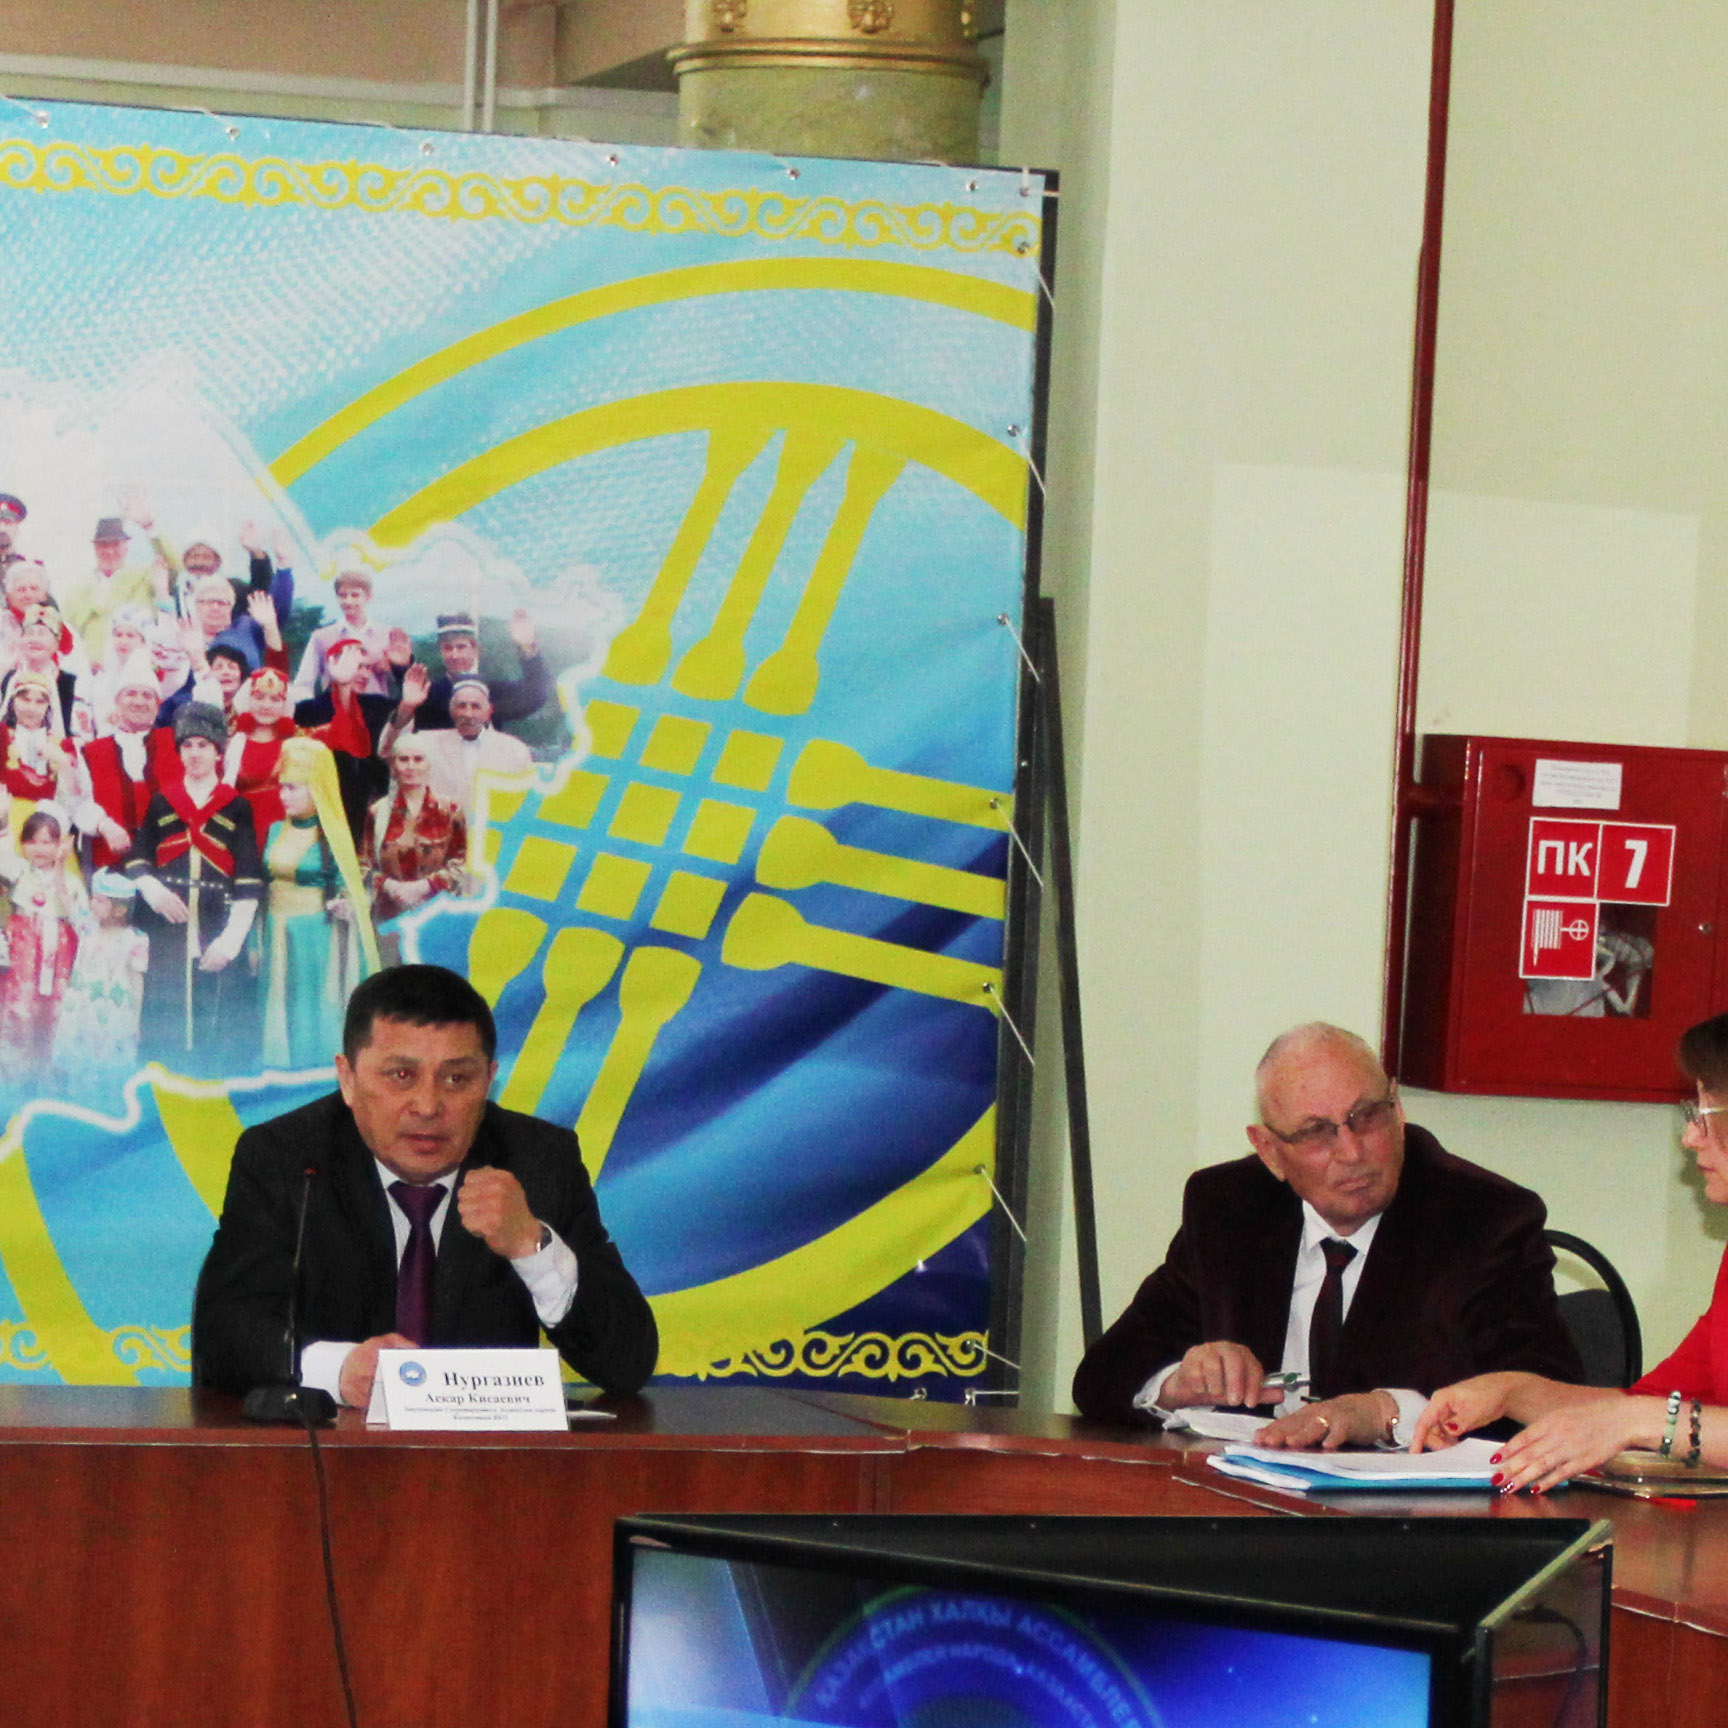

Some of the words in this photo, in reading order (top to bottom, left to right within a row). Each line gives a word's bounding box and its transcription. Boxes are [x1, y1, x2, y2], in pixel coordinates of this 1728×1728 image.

[1537, 839, 1594, 876] ПК
[1624, 839, 1648, 889] 7
[444, 1373, 544, 1390] Нургазиев
